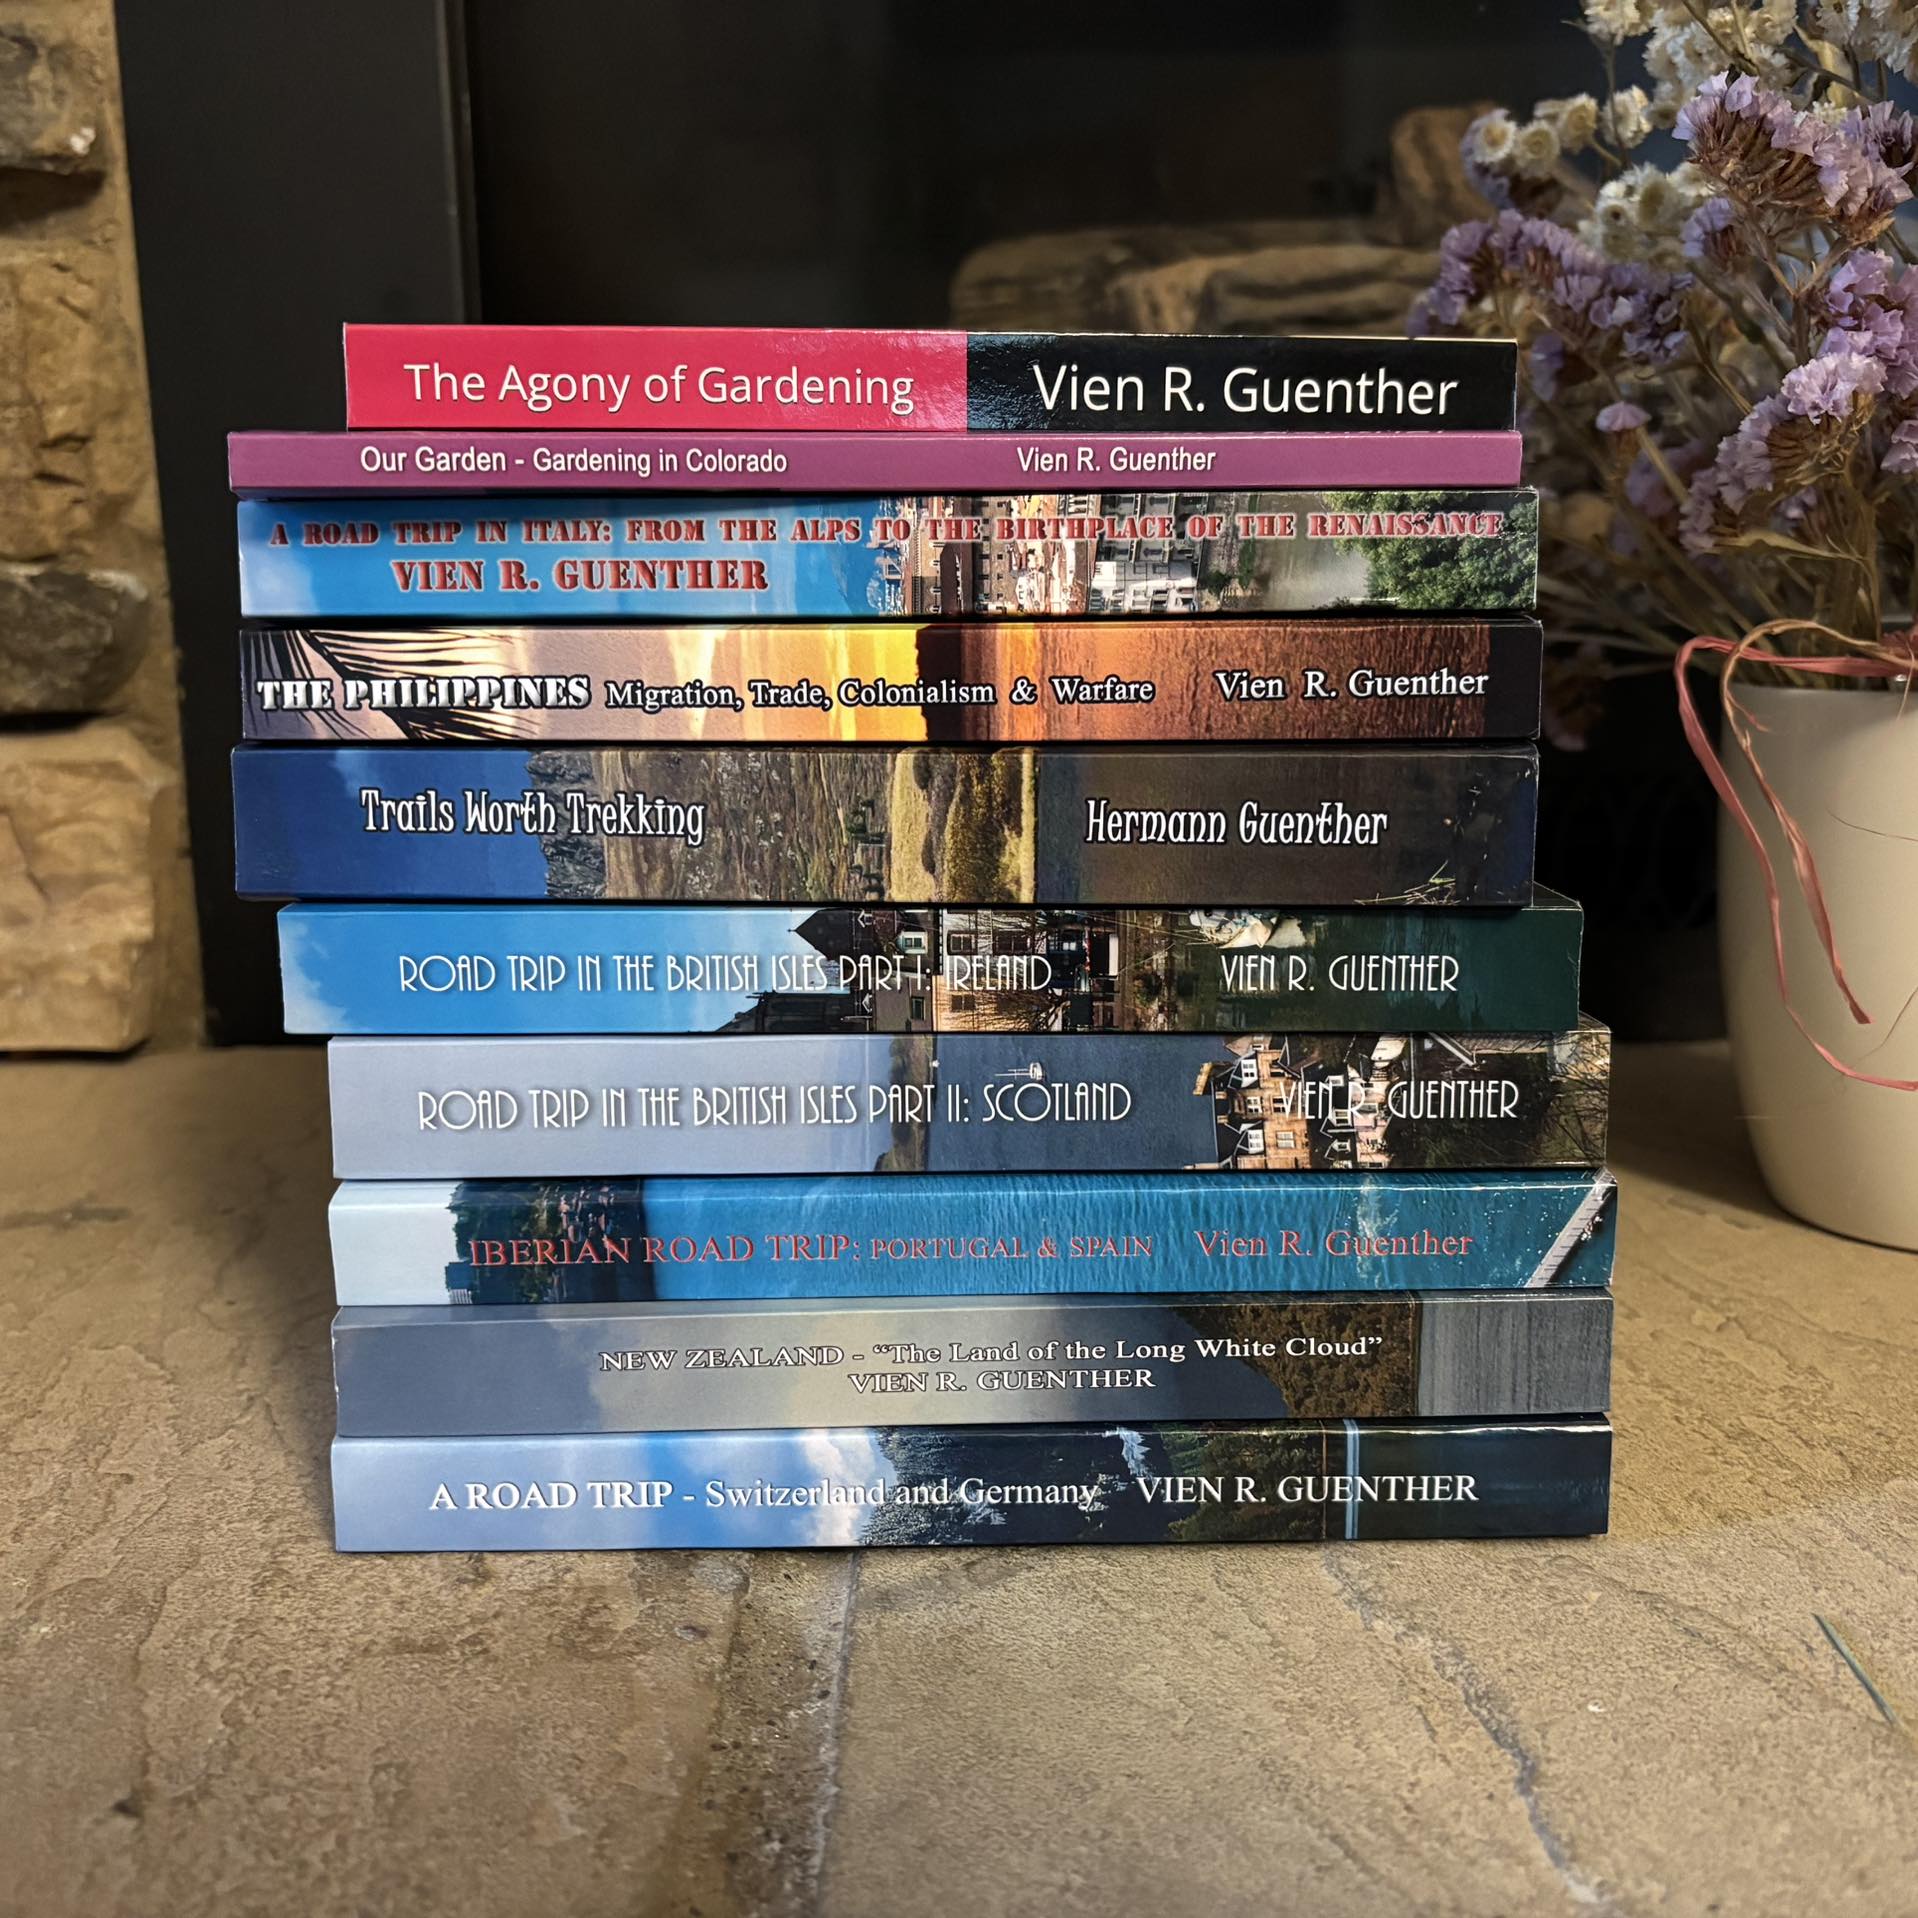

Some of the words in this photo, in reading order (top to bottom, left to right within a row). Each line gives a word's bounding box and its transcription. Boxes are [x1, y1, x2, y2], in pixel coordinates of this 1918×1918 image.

[404, 364, 485, 401] The
[500, 366, 630, 413] Agony
[644, 364, 686, 402] of
[698, 366, 913, 415] Gardening
[1034, 365, 1143, 411] Vien
[1163, 368, 1205, 411] R.
[1224, 368, 1457, 415] Guenther
[361, 446, 406, 472] Our
[415, 447, 506, 472] Garden
[533, 449, 651, 478] Gardening
[659, 449, 678, 472] in
[685, 448, 787, 472] Colorado
[1017, 447, 1068, 472] Vien
[1076, 448, 1101, 472] R.
[1109, 448, 1216, 472] Guenther
[270, 524, 289, 545] A
[304, 523, 378, 545] ROAD
[395, 522, 461, 544] TRIP
[476, 521, 507, 542] IN
[523, 520, 611, 542] ITALY:
[626, 520, 704, 542] FROM
[719, 519, 776, 541] THE
[791, 519, 861, 541] ALPS
[879, 519, 910, 541] TO
[928, 517, 981, 540] THE
[996, 516, 1173, 539] BIRTHPLACE
[1188, 514, 1224, 538] OF
[1238, 514, 1294, 538] THE
[1309, 512, 1504, 537] RENAISSANCE
[392, 560, 484, 592] VIEN
[499, 560, 539, 591] R.
[555, 559, 768, 590] GUENTHER
[256, 680, 332, 709] THE
[344, 676, 590, 708] PHILIPPINES
[605, 682, 743, 711] Migration,
[751, 681, 830, 709] Trade,
[840, 678, 998, 706] Colonialism
[1011, 679, 1035, 704] &
[1051, 679, 1155, 703] Warfare
[1214, 672, 1285, 699] Vien
[1304, 672, 1337, 698] R.
[1349, 669, 1489, 697] Guenther
[362, 789, 454, 832] Trails
[465, 791, 556, 834] Worth
[566, 791, 704, 845] Trekking
[1086, 800, 1227, 843] Hermann
[1240, 801, 1387, 845] Guenther
[400, 956, 495, 991] ROAD
[508, 956, 566, 991] TRIP
[578, 956, 601, 991] IN
[614, 956, 654, 991] THE
[667, 956, 759, 991] BRITISH
[772, 956, 827, 991] ISLES
[841, 956, 904, 990] PART
[917, 956, 931, 990] I:
[945, 956, 1051, 991] IRELAND
[1221, 955, 1275, 991] VIEN
[1288, 955, 1314, 991] R.
[1330, 955, 1458, 991] GUENTHER
[419, 1090, 517, 1130] ROAD
[529, 1089, 589, 1128] TRIP
[603, 1088, 625, 1127] IN
[637, 1088, 680, 1126] THE
[693, 1087, 786, 1125] BRITISH
[799, 1086, 857, 1124] ISLES
[869, 1085, 935, 1123] PART
[947, 1084, 970, 1122] II:
[983, 1082, 1131, 1122] SCOTLAND
[1277, 1081, 1332, 1119] VIEN
[1389, 1080, 1519, 1119] GUENTHER
[469, 1238, 630, 1267] IBERIAN
[643, 1236, 753, 1263] ROAD
[766, 1235, 861, 1261] TRIP:
[872, 1238, 1029, 1259] PORTUGAL
[1039, 1238, 1058, 1256] &
[1071, 1236, 1153, 1257] SPAIN
[1195, 1230, 1268, 1256] Vien
[1279, 1230, 1311, 1255] R.
[1326, 1229, 1472, 1255] Guenther
[599, 1351, 673, 1372] NEW
[685, 1347, 844, 1369] ZEALAND
[872, 1342, 941, 1364] “The
[950, 1342, 1020, 1363] Land
[1028, 1340, 1058, 1361] of
[1065, 1339, 1106, 1360] the
[1116, 1339, 1185, 1363] Long
[1195, 1338, 1276, 1358] White
[1286, 1336, 1382, 1357] Cloud”
[848, 1373, 928, 1393] VIEN
[938, 1371, 966, 1391] R.
[977, 1368, 1155, 1390] GUENTHER
[429, 1484, 458, 1510] A
[465, 1482, 577, 1510] ROAD
[588, 1482, 672, 1508] TRIP
[705, 1480, 887, 1507] Switzerland
[896, 1480, 948, 1505] and
[961, 1478, 1099, 1511] Germany
[1137, 1476, 1228, 1503] VIEN
[1235, 1477, 1267, 1502] R.
[1278, 1475, 1479, 1502] GUENTHER
